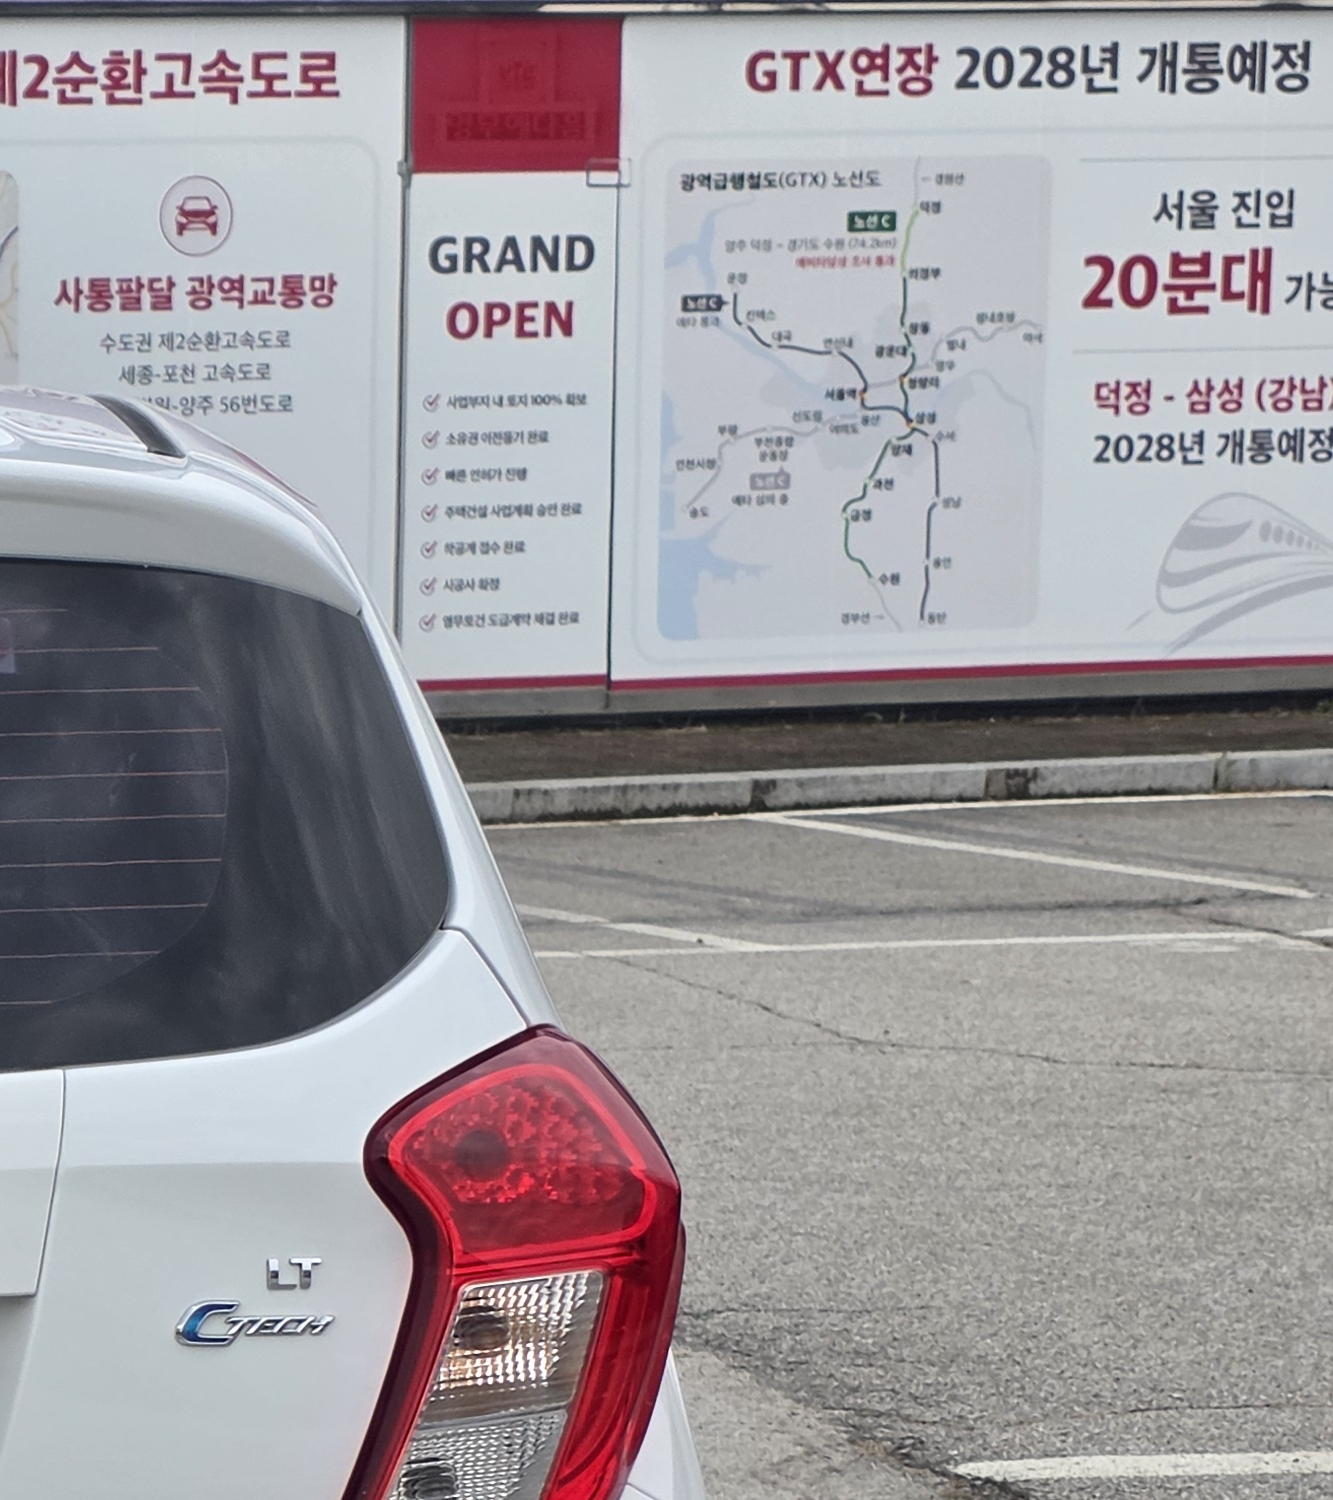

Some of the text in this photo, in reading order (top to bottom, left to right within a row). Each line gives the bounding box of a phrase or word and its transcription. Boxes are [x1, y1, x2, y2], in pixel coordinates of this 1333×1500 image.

[744, 41, 1312, 96] GTX연장 2028년 개통예정
[680, 170, 882, 192] 광역급행철도(GTX) 노선도
[1153, 188, 1296, 230] 서울 진입
[428, 234, 595, 275] GRAND
[54, 273, 338, 313] 사통팔달 광역교통망
[1081, 246, 1274, 316] 20분대
[445, 300, 574, 340] OPEN
[100, 331, 292, 354] 수도권 제2순환고속도로
[118, 363, 272, 385] 세종-포천 고속도로
[219, 395, 293, 414] 56번도로
[530, 393, 563, 406] 100%
[1094, 379, 1152, 416] 덕정
[1185, 376, 1245, 415] 삼성
[1256, 374, 1333, 412] (강남)
[1093, 426, 1333, 466] 2028년 개통예정
[266, 1257, 322, 1290] LT
